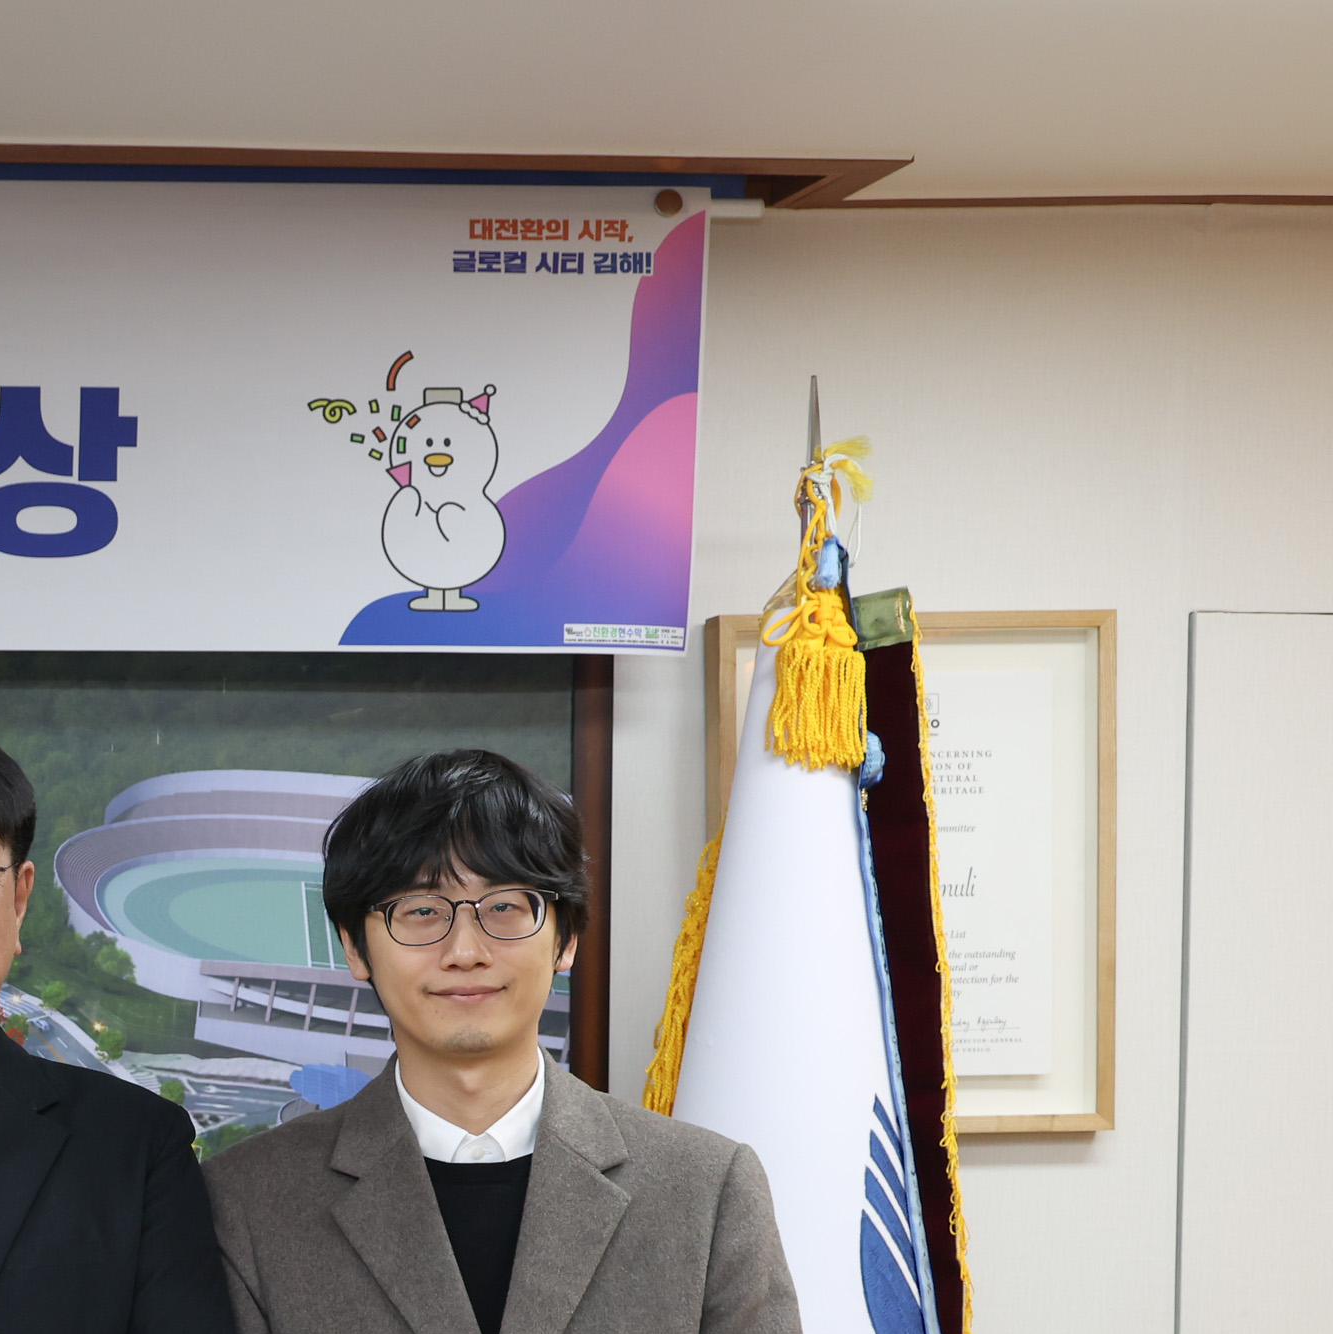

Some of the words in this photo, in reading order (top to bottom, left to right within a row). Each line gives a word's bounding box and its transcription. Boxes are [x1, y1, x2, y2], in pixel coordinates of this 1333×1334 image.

[468, 217, 569, 242] 대전환의
[577, 218, 634, 244] 시작,
[451, 250, 527, 275] 글로컬
[534, 250, 585, 275] 시티
[593, 250, 653, 275] 김해!
[930, 750, 993, 758] NCERNING
[933, 786, 985, 794] ERITAGE
[950, 930, 967, 939] List
[948, 950, 963, 959] the
[964, 950, 1017, 962] outstanding
[968, 964, 979, 972] or
[949, 974, 989, 985] rotection
[989, 974, 1003, 987] for
[1005, 974, 1019, 984] the
